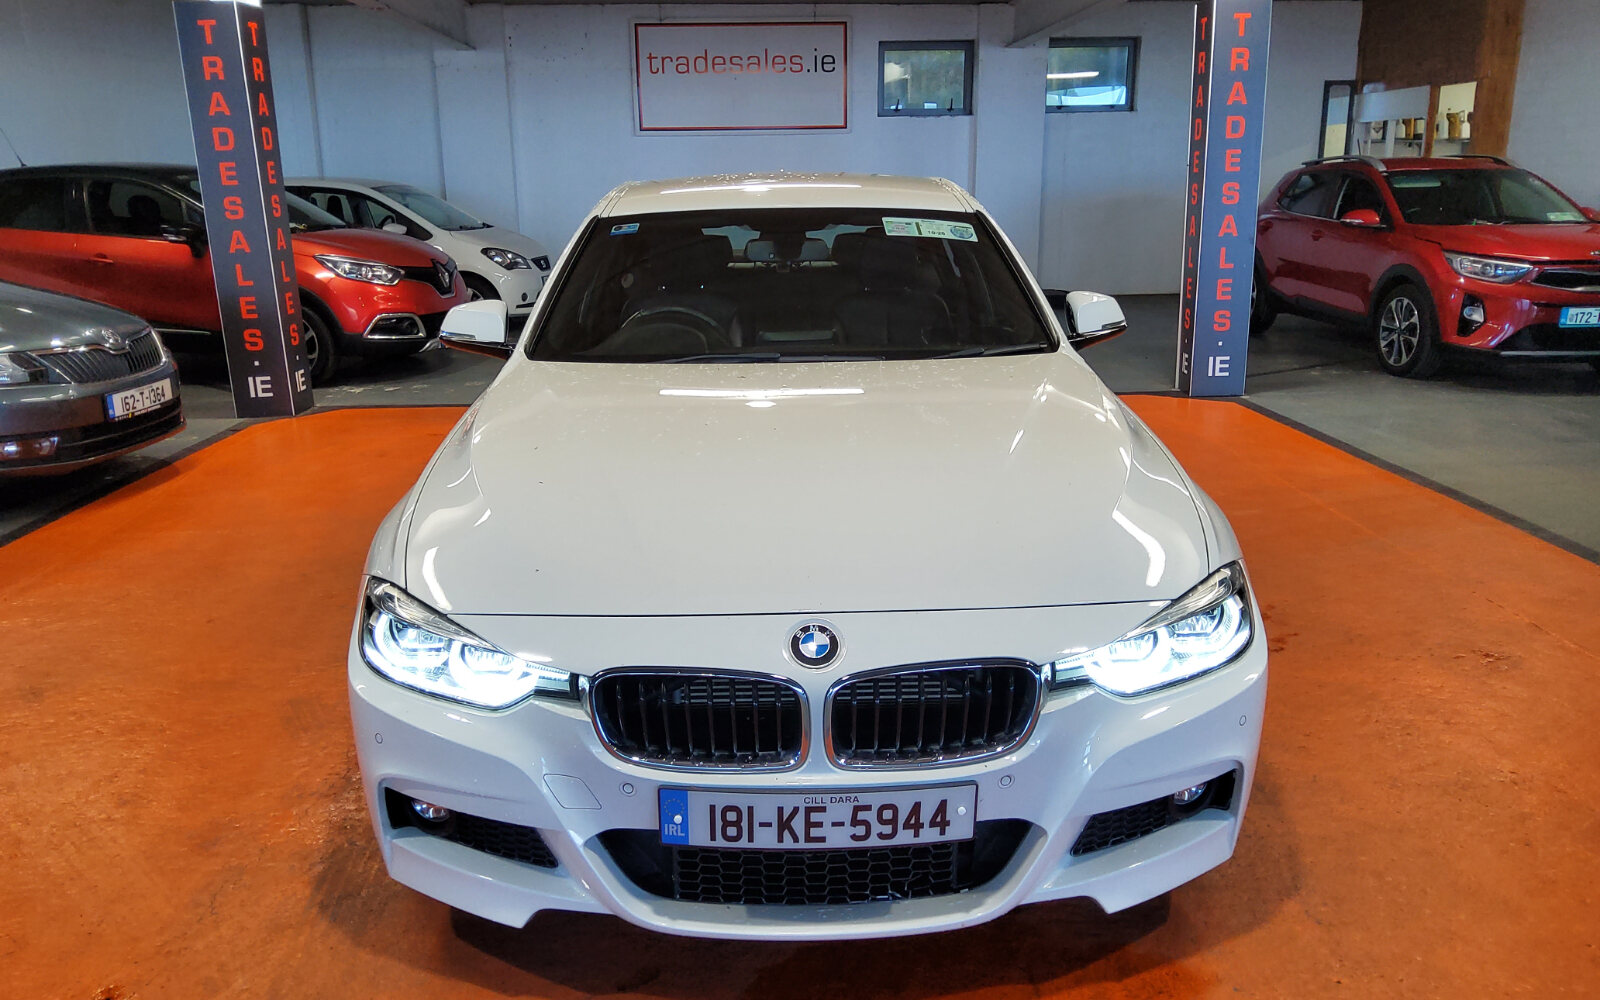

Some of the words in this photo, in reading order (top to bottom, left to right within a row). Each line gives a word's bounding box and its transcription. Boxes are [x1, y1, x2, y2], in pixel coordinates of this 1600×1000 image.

[646, 48, 836, 75] tradesales.ie
[1574, 311, 1600, 323] 172-
[121, 384, 166, 413] 162-T-1364
[803, 796, 827, 805] CILL
[829, 795, 860, 804] DARA
[664, 823, 685, 837] IRL
[708, 799, 951, 844] 181-KE-5944
